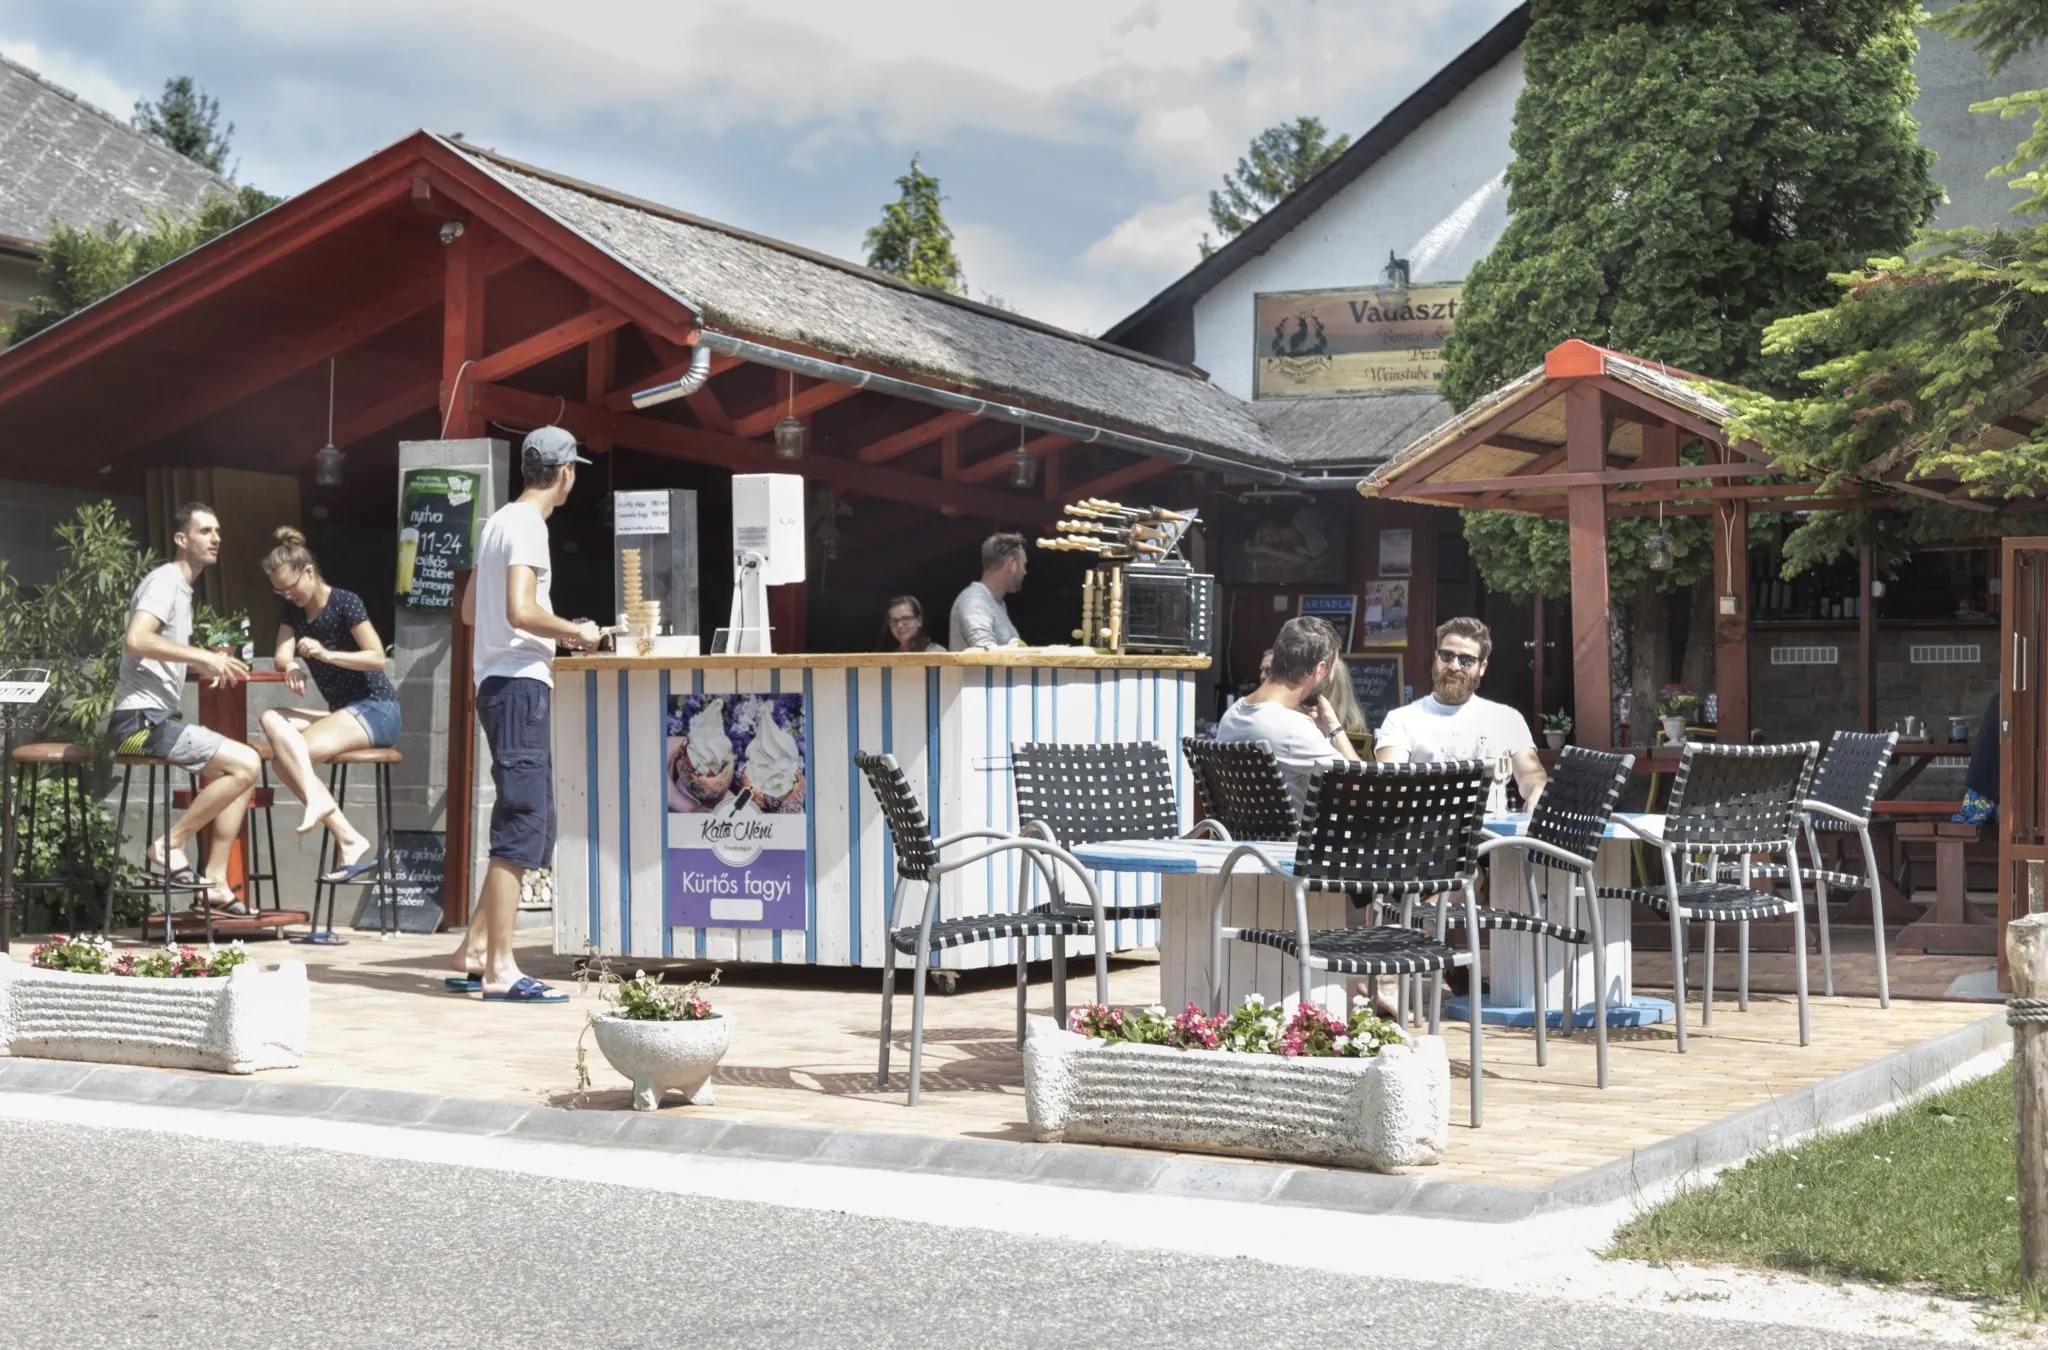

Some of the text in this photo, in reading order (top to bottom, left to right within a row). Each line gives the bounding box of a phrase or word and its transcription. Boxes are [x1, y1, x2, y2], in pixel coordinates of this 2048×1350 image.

[1348, 297, 1458, 324] Vadászt
[1408, 346, 1437, 362] Pizz
[1365, 364, 1430, 382] Weinstube
[410, 504, 443, 528] nyitva
[421, 531, 462, 554] 11-24
[422, 566, 454, 579] bableve
[734, 821, 774, 842] Néni
[683, 870, 791, 902] Kürtős fagyi
